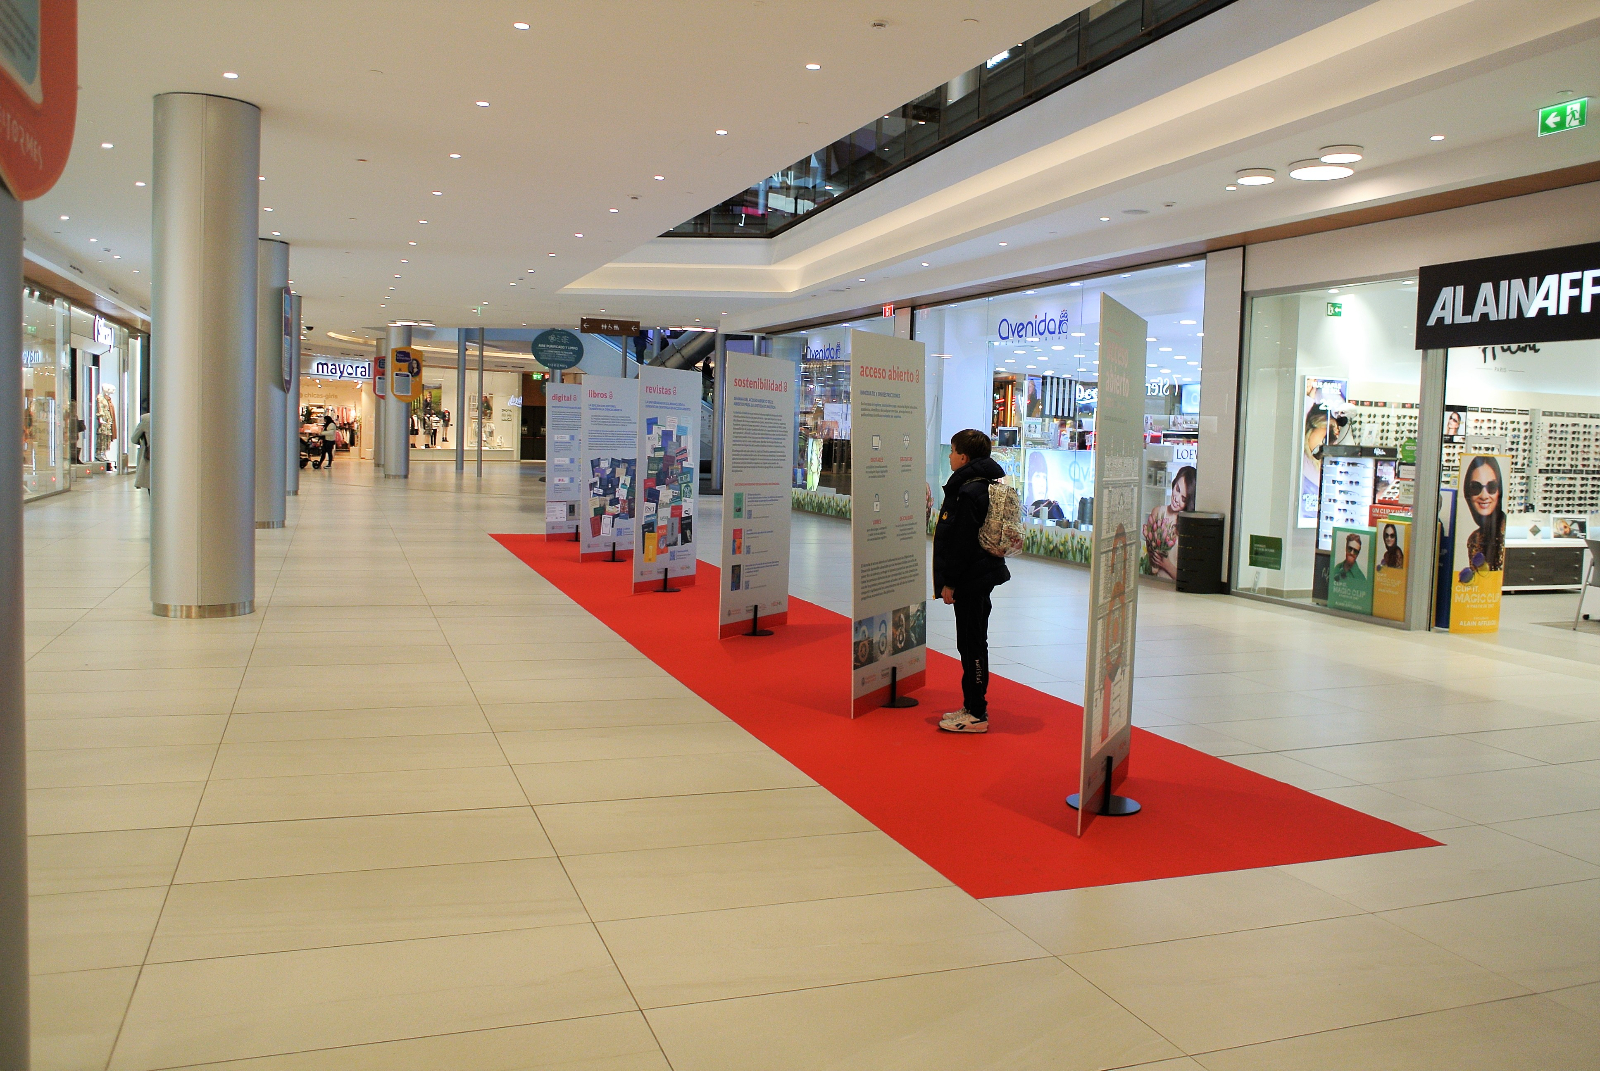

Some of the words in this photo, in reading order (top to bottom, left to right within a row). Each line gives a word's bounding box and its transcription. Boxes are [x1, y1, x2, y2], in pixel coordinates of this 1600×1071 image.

[316, 362, 371, 380] mayoral
[860, 365, 887, 379] acceso
[888, 364, 914, 383] abierto
[645, 384, 672, 396] revistas
[733, 377, 783, 393] sostenibilidad
[551, 393, 572, 403] digital
[588, 389, 608, 399] libros
[1176, 448, 1198, 460] LOE
[1454, 593, 1486, 603] MAGIC
